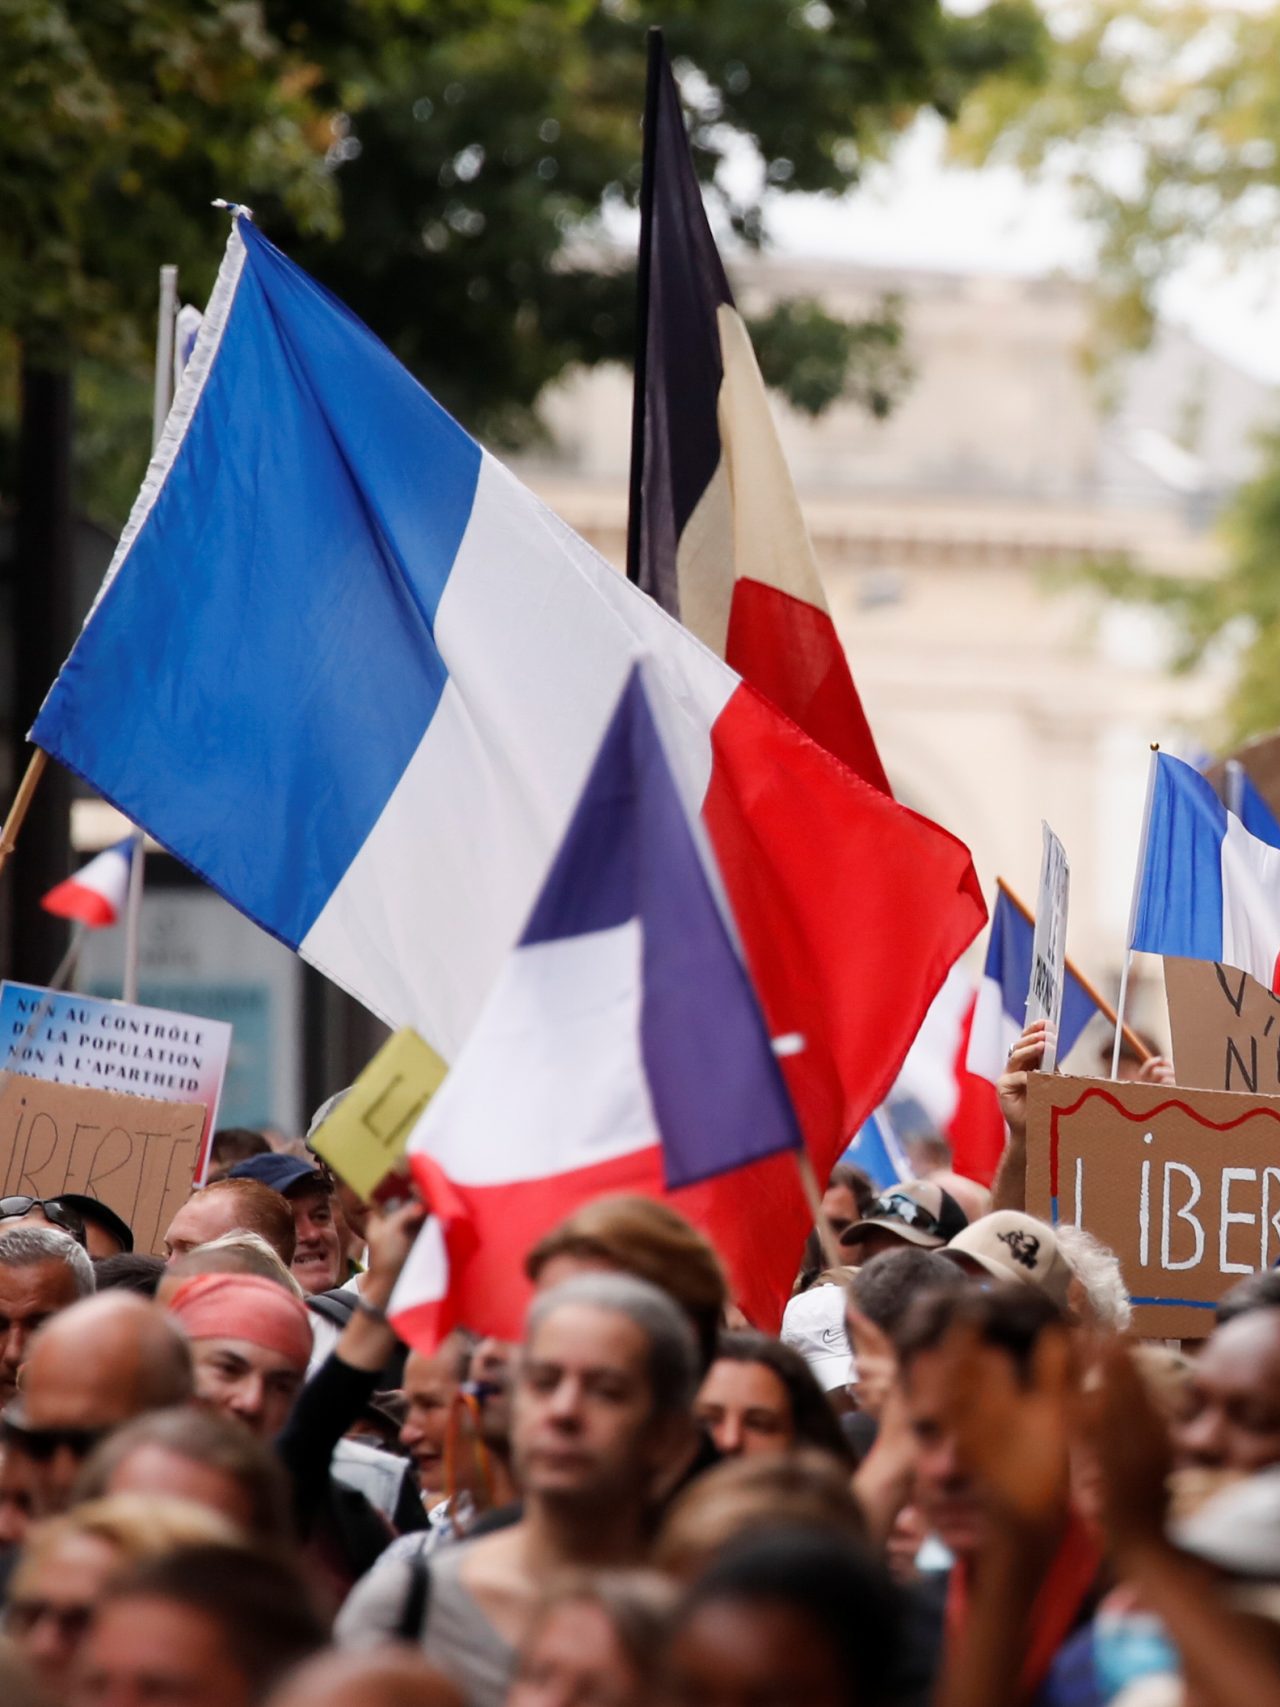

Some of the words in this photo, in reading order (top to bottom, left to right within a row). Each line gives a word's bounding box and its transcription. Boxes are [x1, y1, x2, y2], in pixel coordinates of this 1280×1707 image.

[66, 1007, 91, 1025] AU
[100, 1016, 205, 1047] CONTRÔLE
[47, 1028, 69, 1044] LA
[79, 1034, 203, 1070] POPULATION
[74, 1055, 201, 1093] L'APARTHEID
[3, 1098, 196, 1256] IBERTÉ
